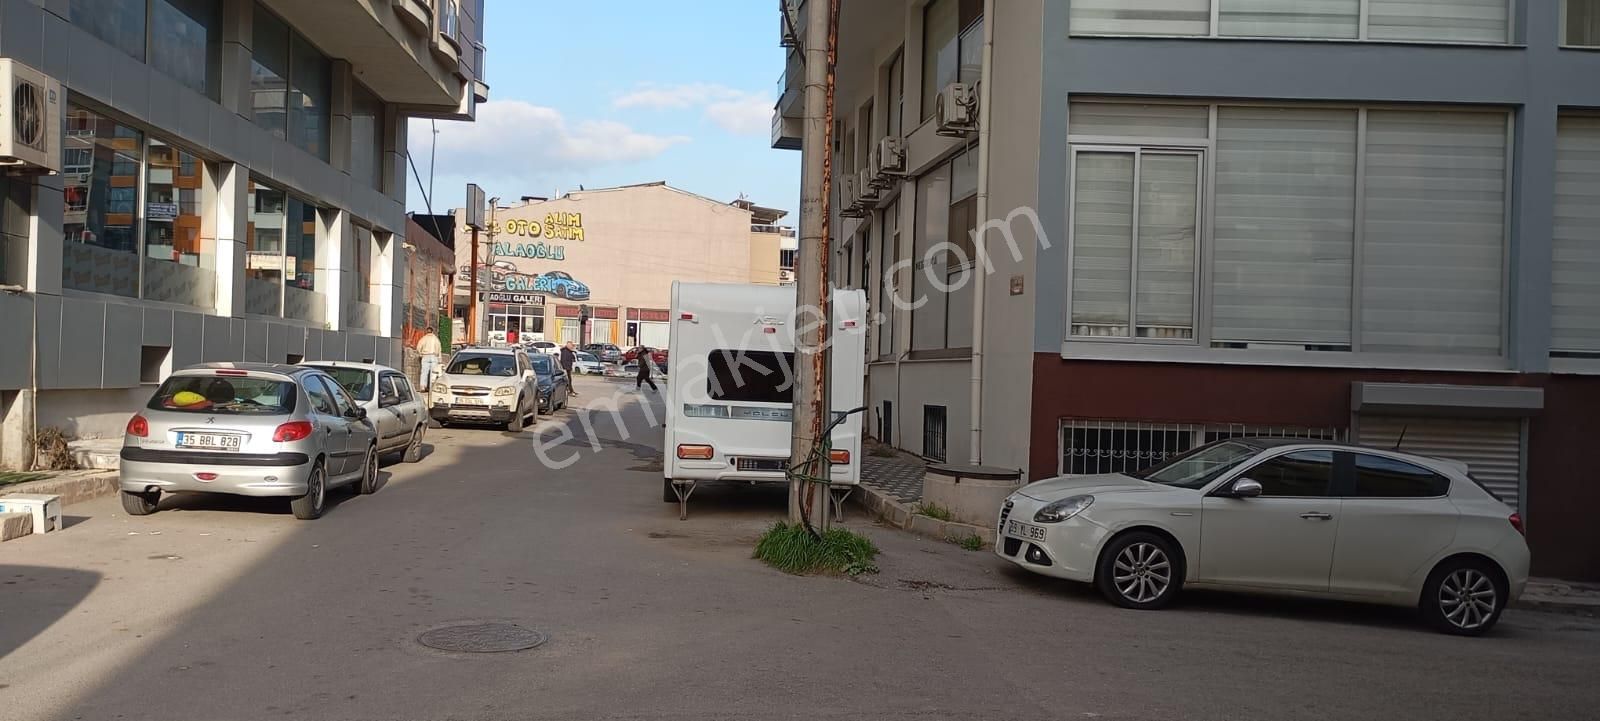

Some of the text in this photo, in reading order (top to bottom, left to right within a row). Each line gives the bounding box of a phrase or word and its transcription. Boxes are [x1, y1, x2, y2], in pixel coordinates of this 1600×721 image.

[544, 212, 582, 227] ALIM
[506, 219, 541, 237] OTO
[544, 225, 584, 241] SATIM
[183, 434, 196, 445] 35
[220, 437, 239, 447] 828
[1030, 526, 1045, 539] 969
